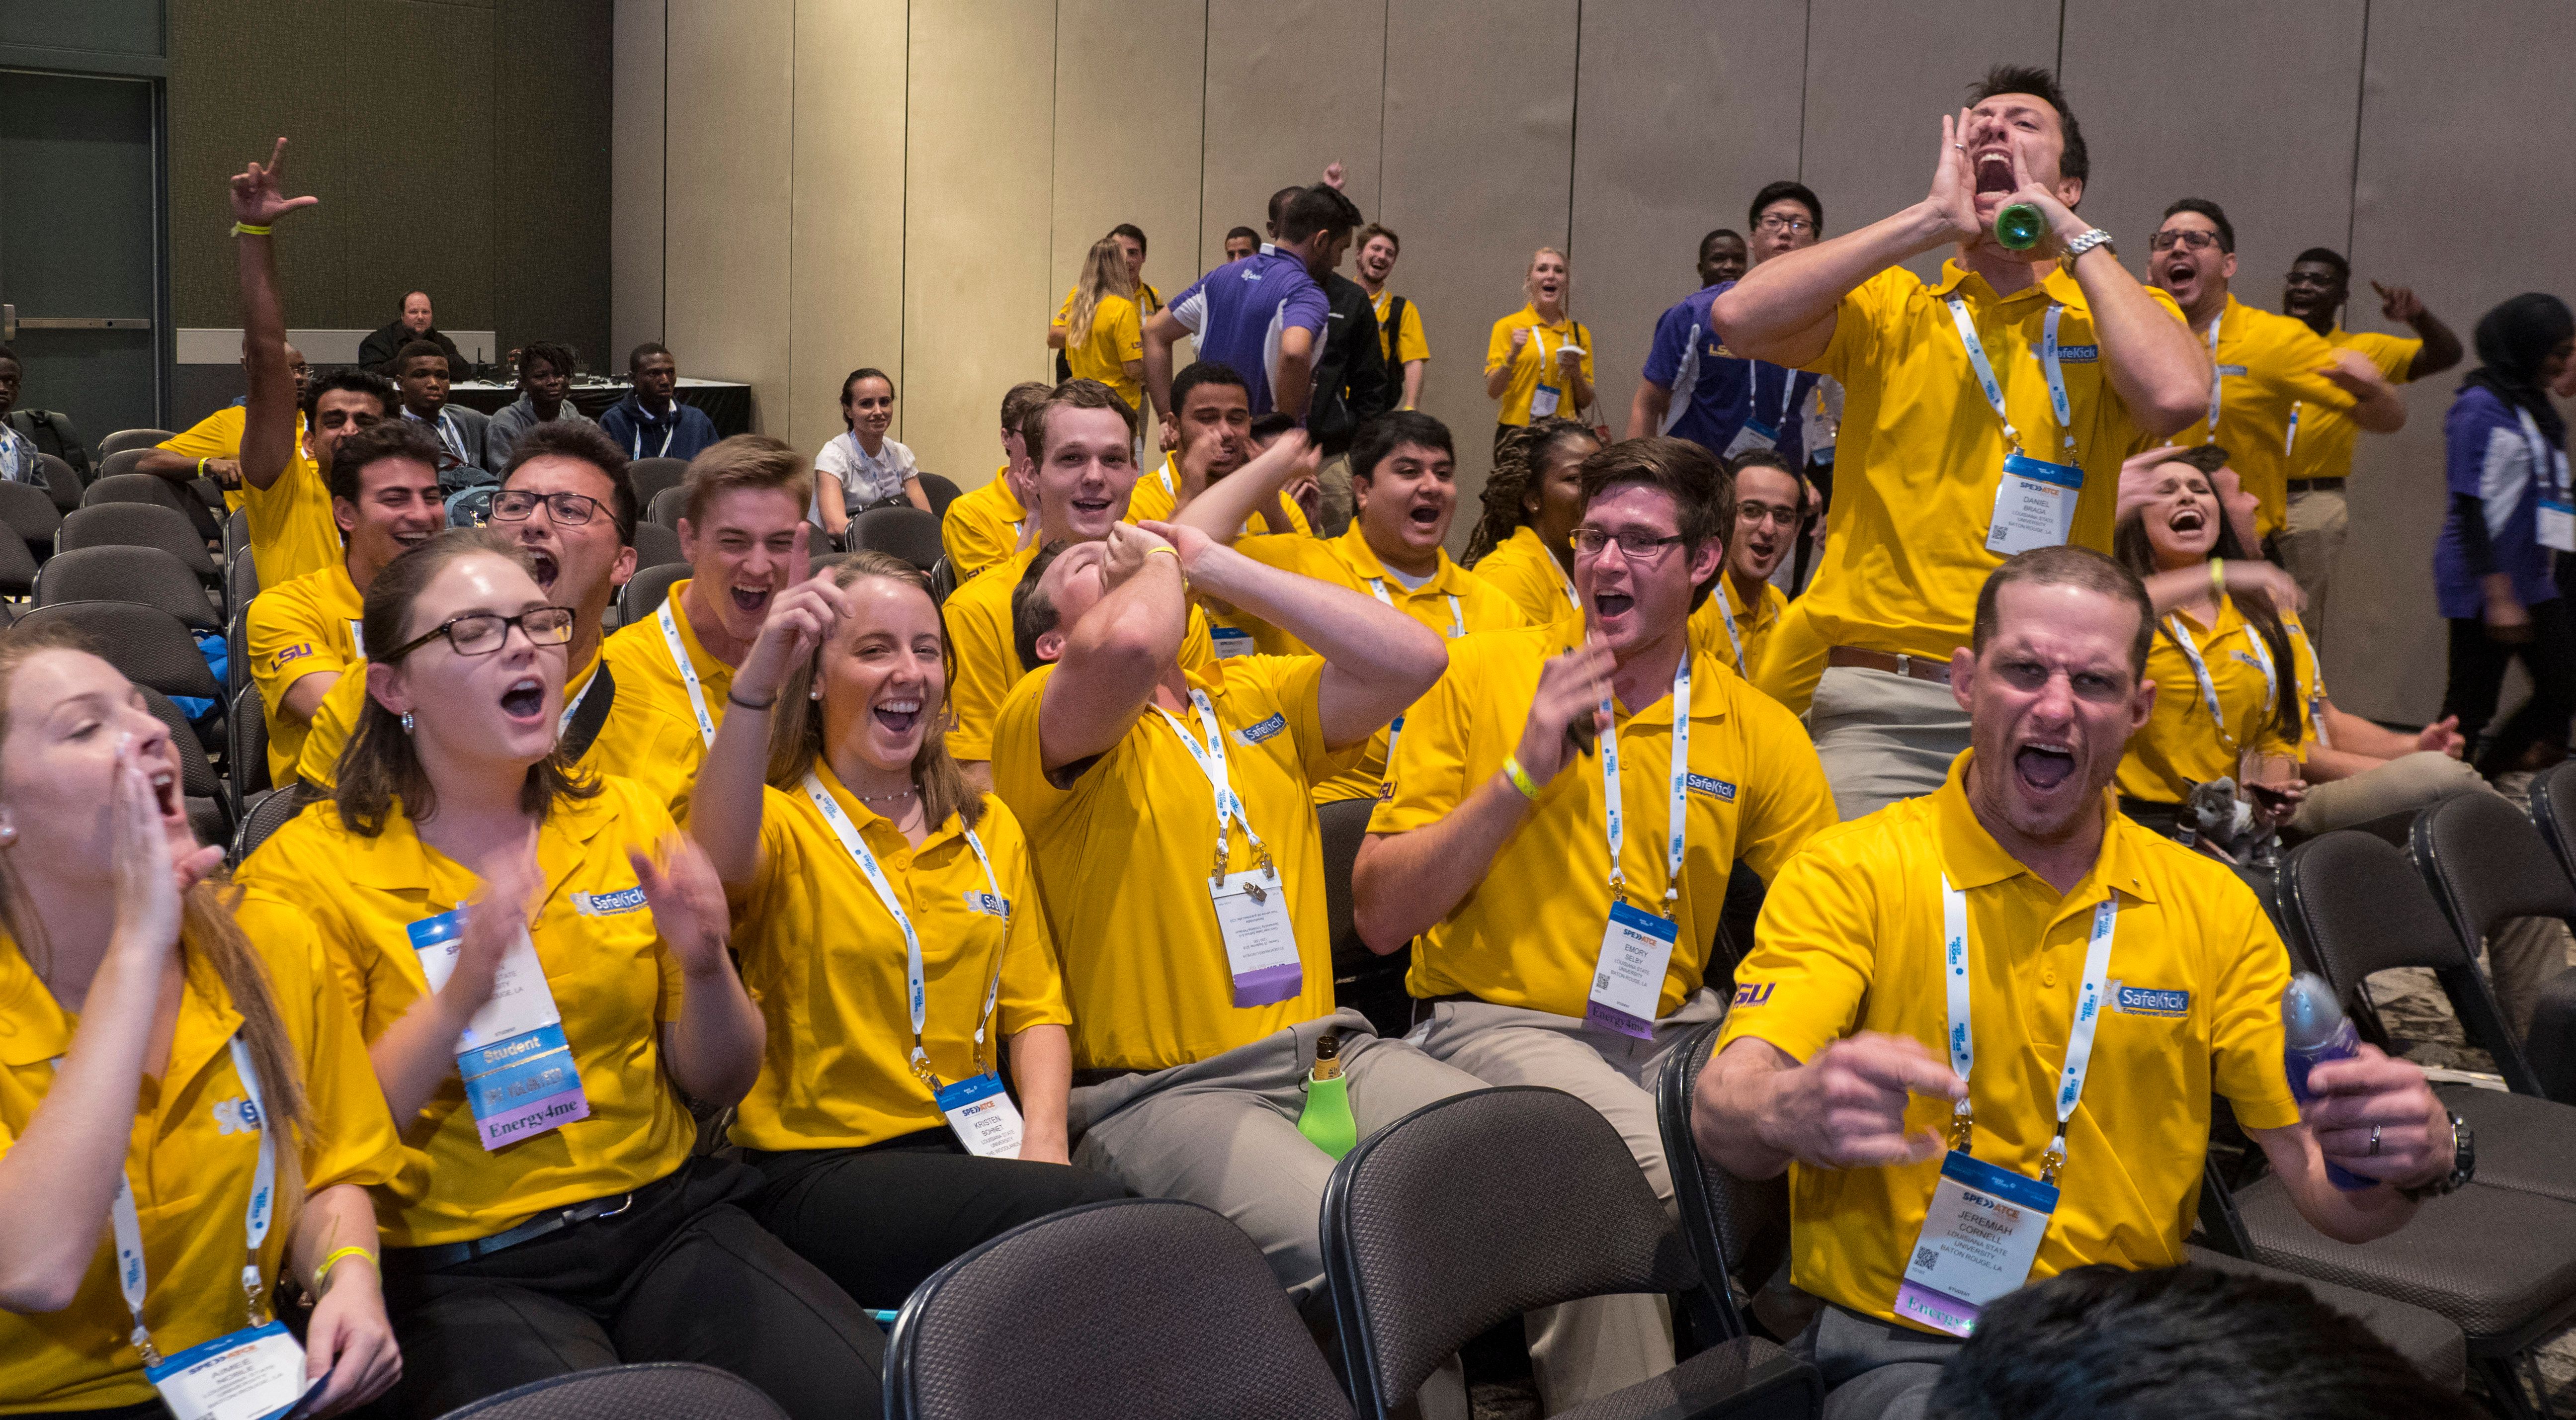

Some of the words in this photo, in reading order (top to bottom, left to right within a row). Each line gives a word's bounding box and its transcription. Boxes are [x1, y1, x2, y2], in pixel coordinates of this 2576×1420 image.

[1709, 343, 1734, 357] LS
[2058, 346, 2095, 358] afeKick
[2023, 497, 2050, 507] DANIEL
[2024, 505, 2046, 514] BRAGA
[271, 643, 313, 671] LSU
[1246, 715, 1284, 740] SafeKick
[1378, 780, 1397, 800] SU
[1687, 775, 1734, 797] SafeKick
[592, 889, 646, 910] SafeKick
[446, 945, 460, 955] SP
[1625, 944, 1648, 957] EMORY
[1625, 954, 1643, 964] SELBY
[1735, 982, 1776, 1005] SU
[2123, 989, 2185, 1009] SafeKick
[1592, 1006, 1646, 1032] Energy4me
[483, 1036, 541, 1064] Student
[489, 1098, 578, 1138] Energy4me
[974, 1115, 1000, 1129] KRISTEN
[982, 1125, 1002, 1136] BOHNET
[1958, 1209, 2012, 1237] JEREMIAH
[1947, 1229, 1984, 1248] LOUISIANA
[1985, 1244, 2007, 1256] STATE
[1958, 1223, 2002, 1245] CORNELL
[1940, 1244, 1964, 1257] BATON
[1993, 1263, 2003, 1272] LA
[1954, 1240, 1995, 1259] UNIVERSITY
[1907, 1296, 1977, 1333] Energy4
